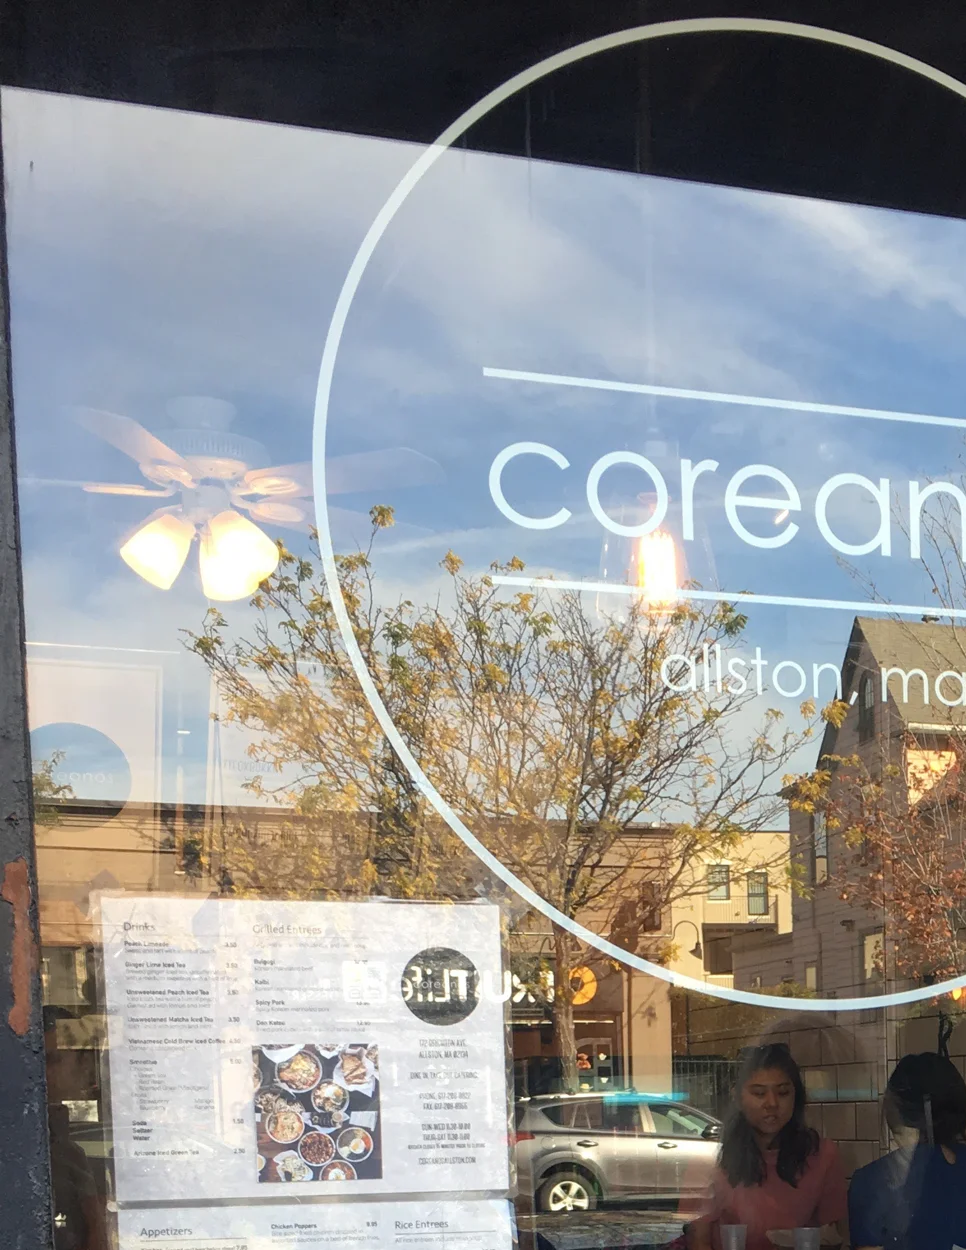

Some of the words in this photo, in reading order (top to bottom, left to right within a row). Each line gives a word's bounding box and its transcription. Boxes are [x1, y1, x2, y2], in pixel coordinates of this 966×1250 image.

[661, 647, 859, 706] allston,
[123, 921, 156, 931] Drinks
[252, 924, 284, 934] Grilled
[287, 925, 322, 934] Entrees
[395, 1221, 413, 1229] Rice
[415, 1220, 449, 1229] Entrees
[140, 1228, 193, 1238] Appetizers
